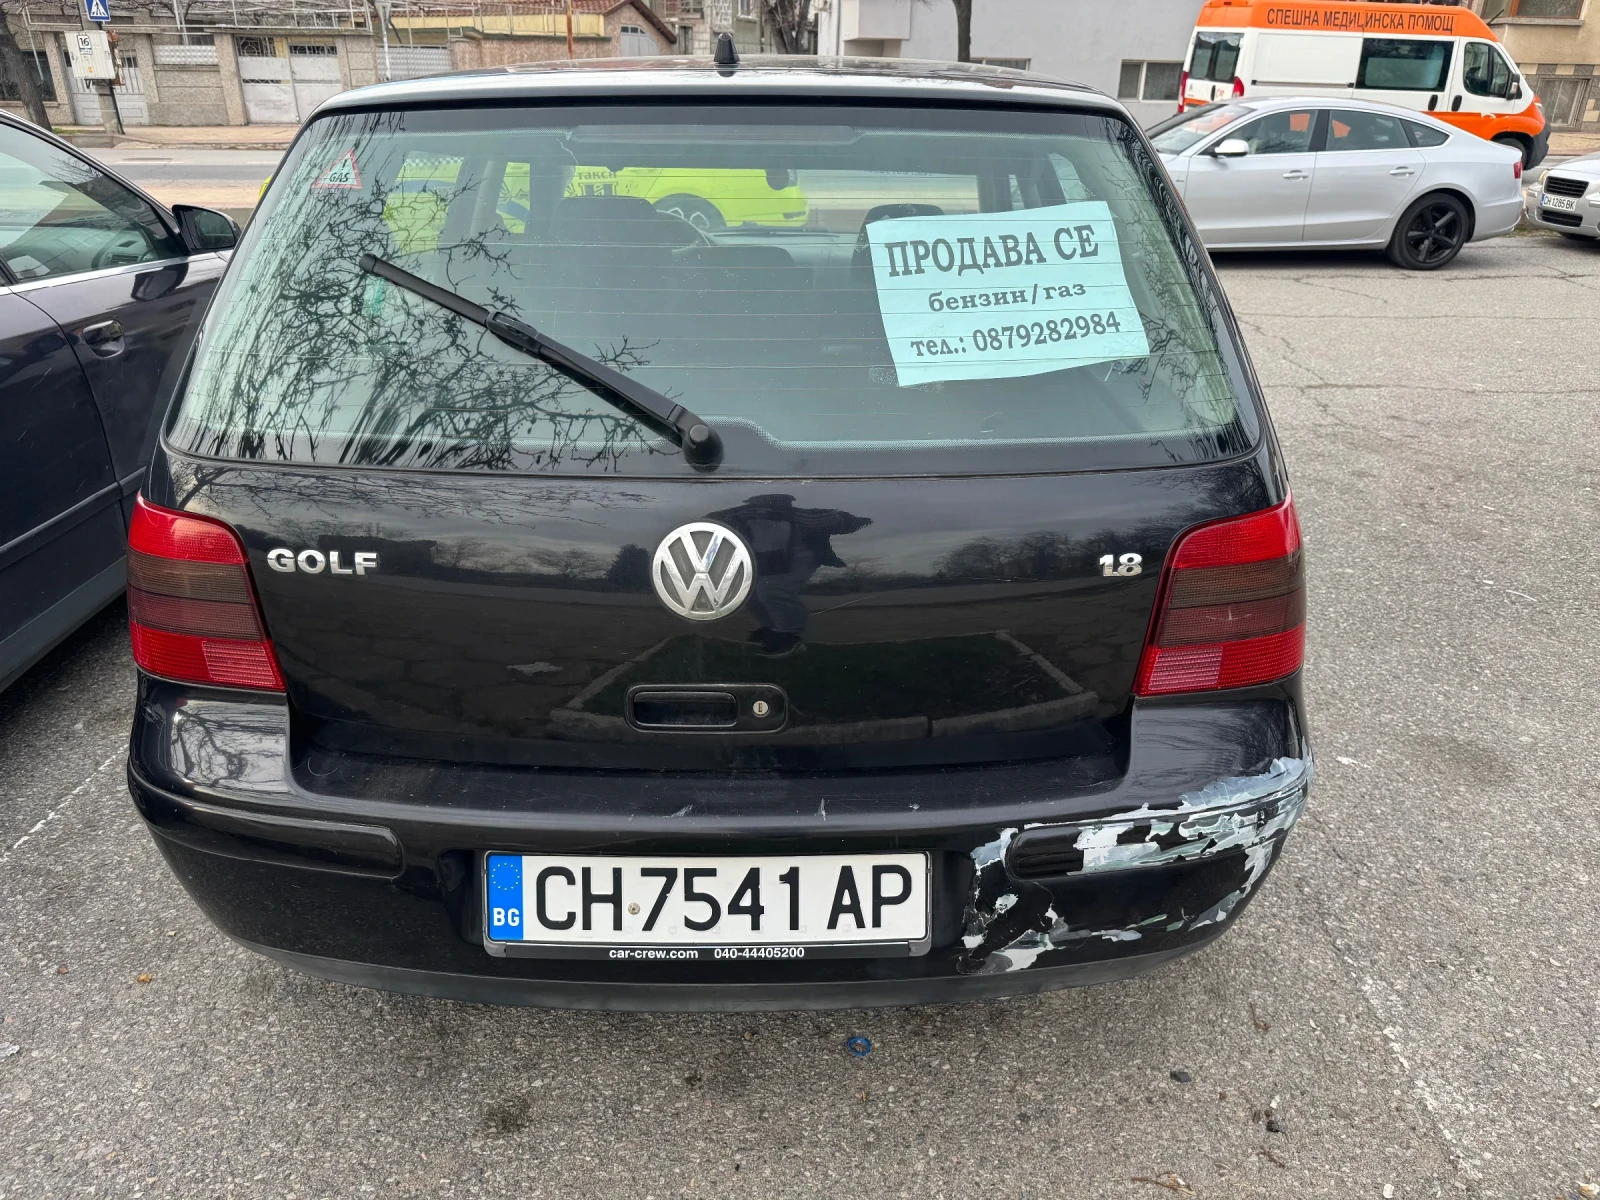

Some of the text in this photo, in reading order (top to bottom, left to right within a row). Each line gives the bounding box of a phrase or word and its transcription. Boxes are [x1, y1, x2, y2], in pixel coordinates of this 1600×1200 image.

[1266, 8, 1454, 35] СПЕШНА МЕДИЦИНСКА ПОМОЩ
[79, 37, 90, 47] 16
[329, 172, 351, 183] GAS
[884, 224, 1099, 277] ПРОДАВА СЕ
[910, 311, 1121, 357] тел.: 0879282984
[266, 547, 378, 576] GOLF
[535, 864, 912, 931] CH 7541 AP
[492, 907, 520, 927] BG
[608, 947, 806, 960] car-crew.com 040-44405200
